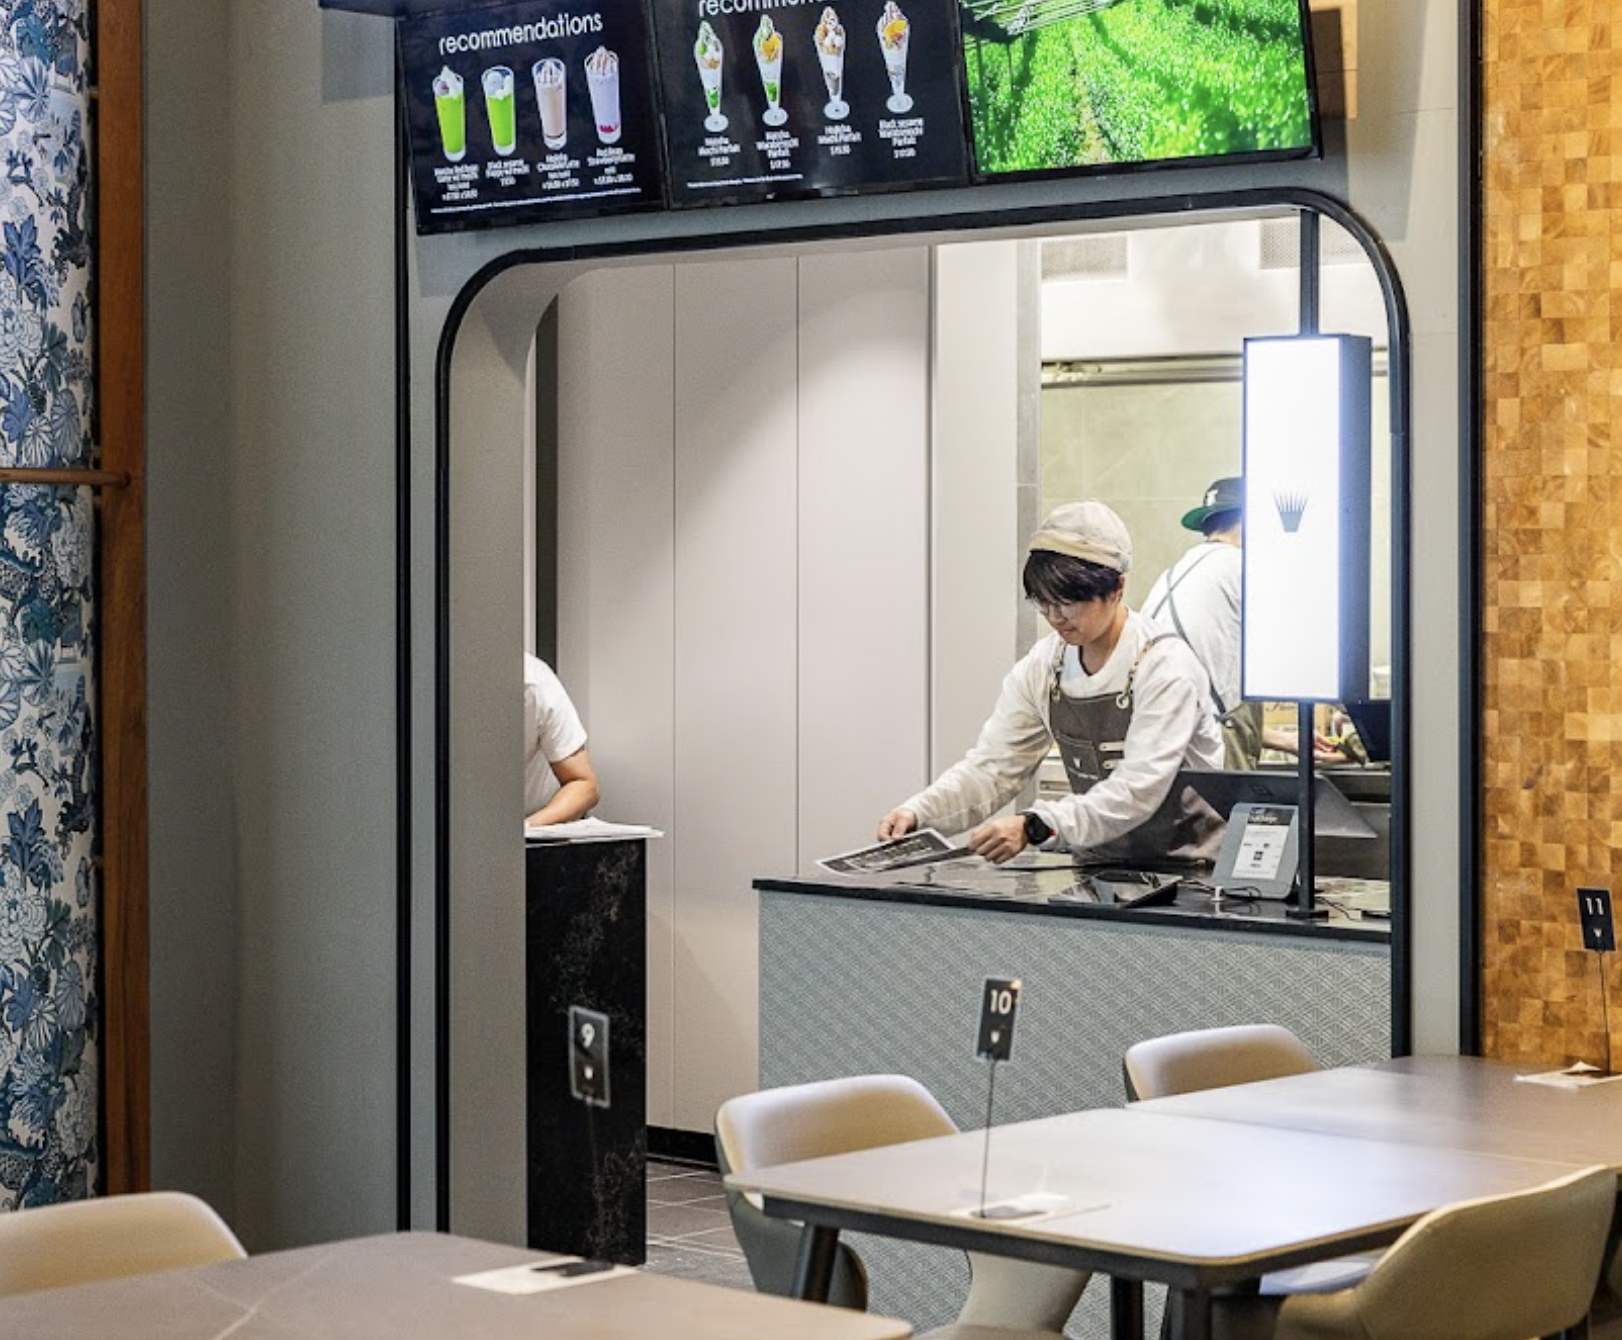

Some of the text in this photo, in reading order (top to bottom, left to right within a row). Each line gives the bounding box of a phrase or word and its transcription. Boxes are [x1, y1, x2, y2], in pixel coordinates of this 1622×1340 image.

[698, 0, 831, 17] recomm
[438, 12, 604, 56] recommendations
[1585, 897, 1604, 915] 11
[990, 989, 1012, 1015] 10
[581, 1022, 595, 1048] 9
